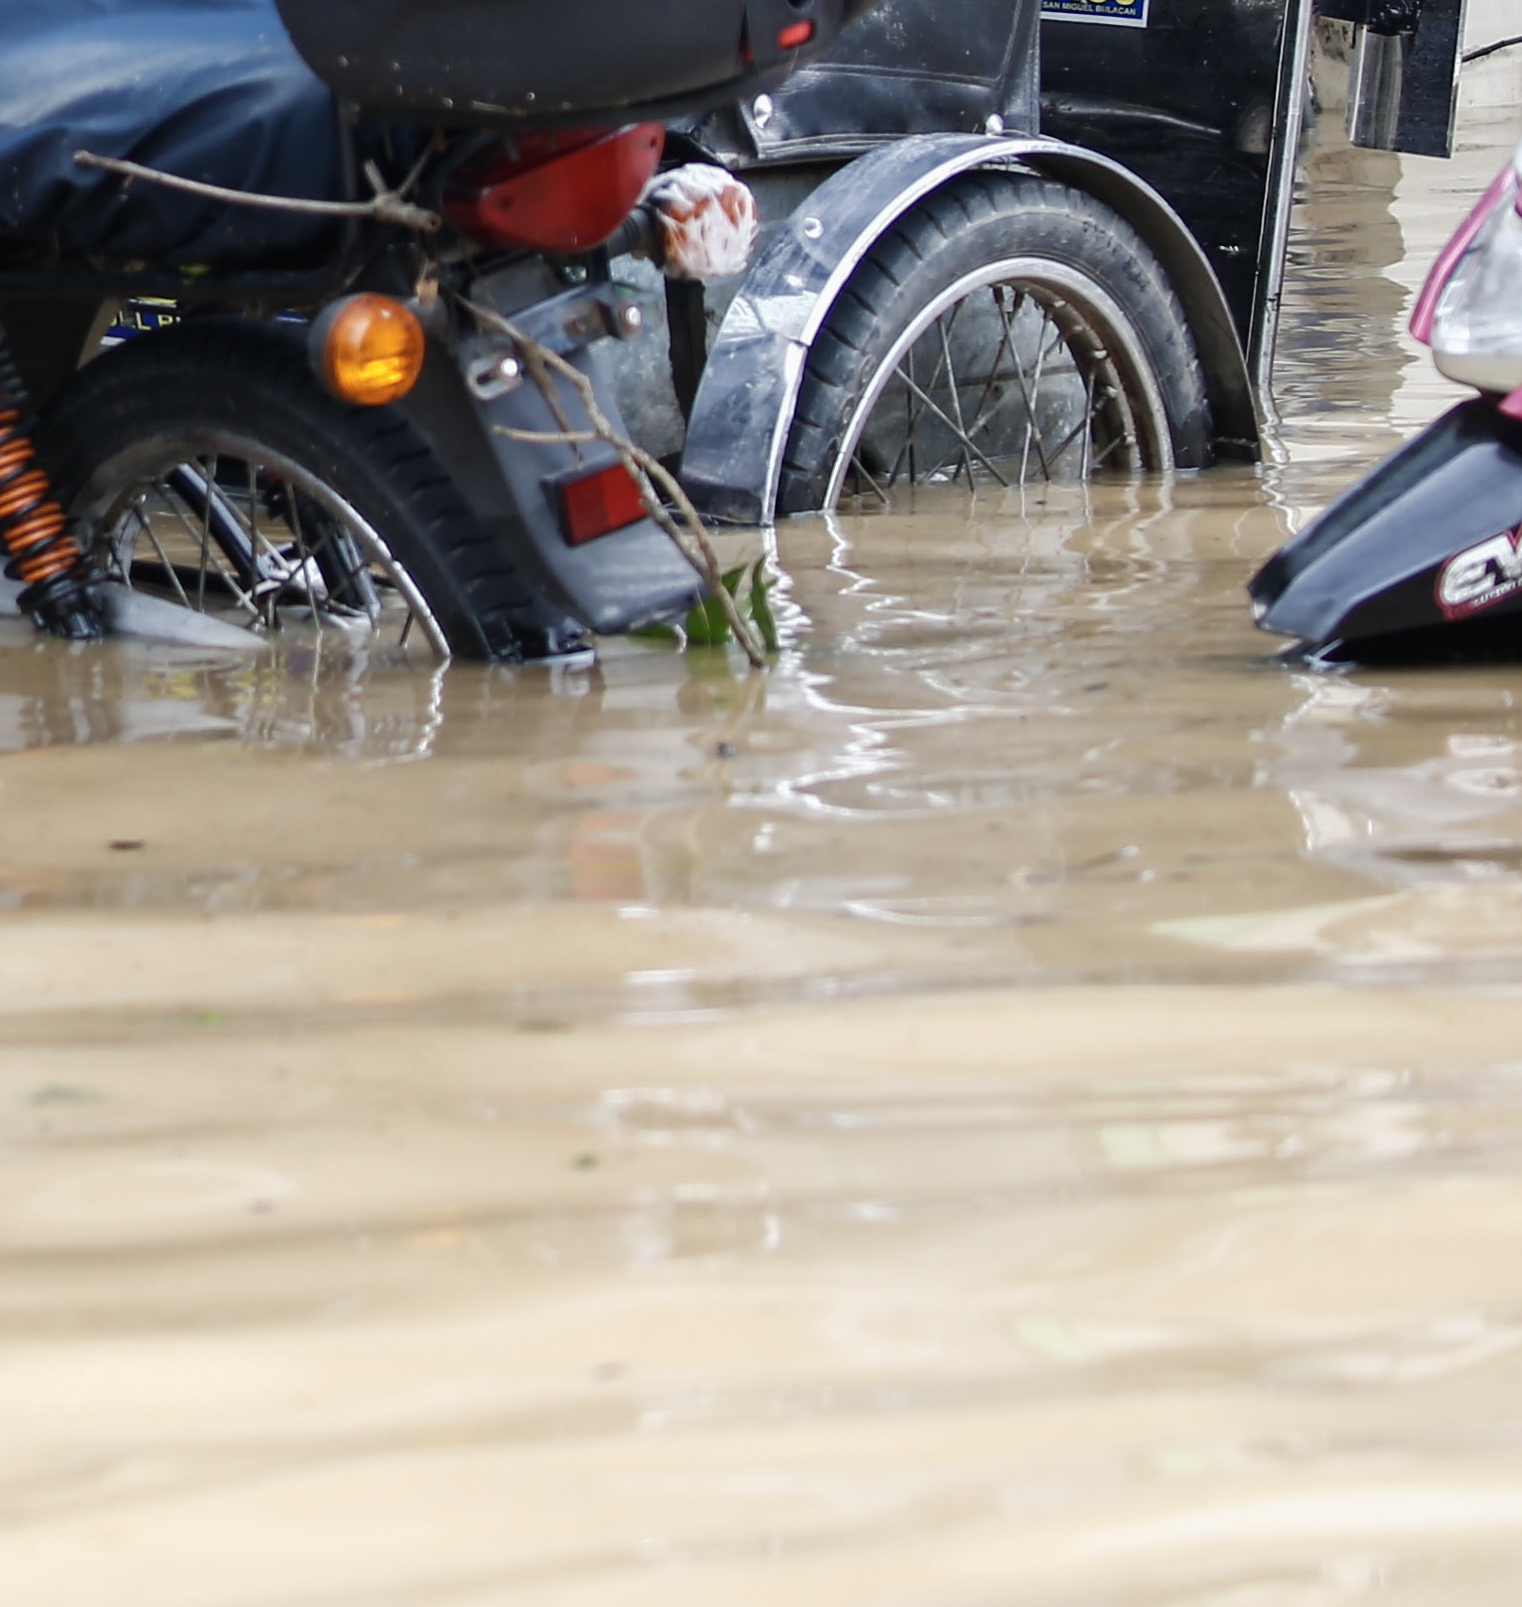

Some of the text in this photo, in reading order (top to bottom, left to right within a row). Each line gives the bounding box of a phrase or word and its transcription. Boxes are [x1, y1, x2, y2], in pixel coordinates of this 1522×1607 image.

[1043, 1, 1137, 16] SAN MIGUEL BULACAN
